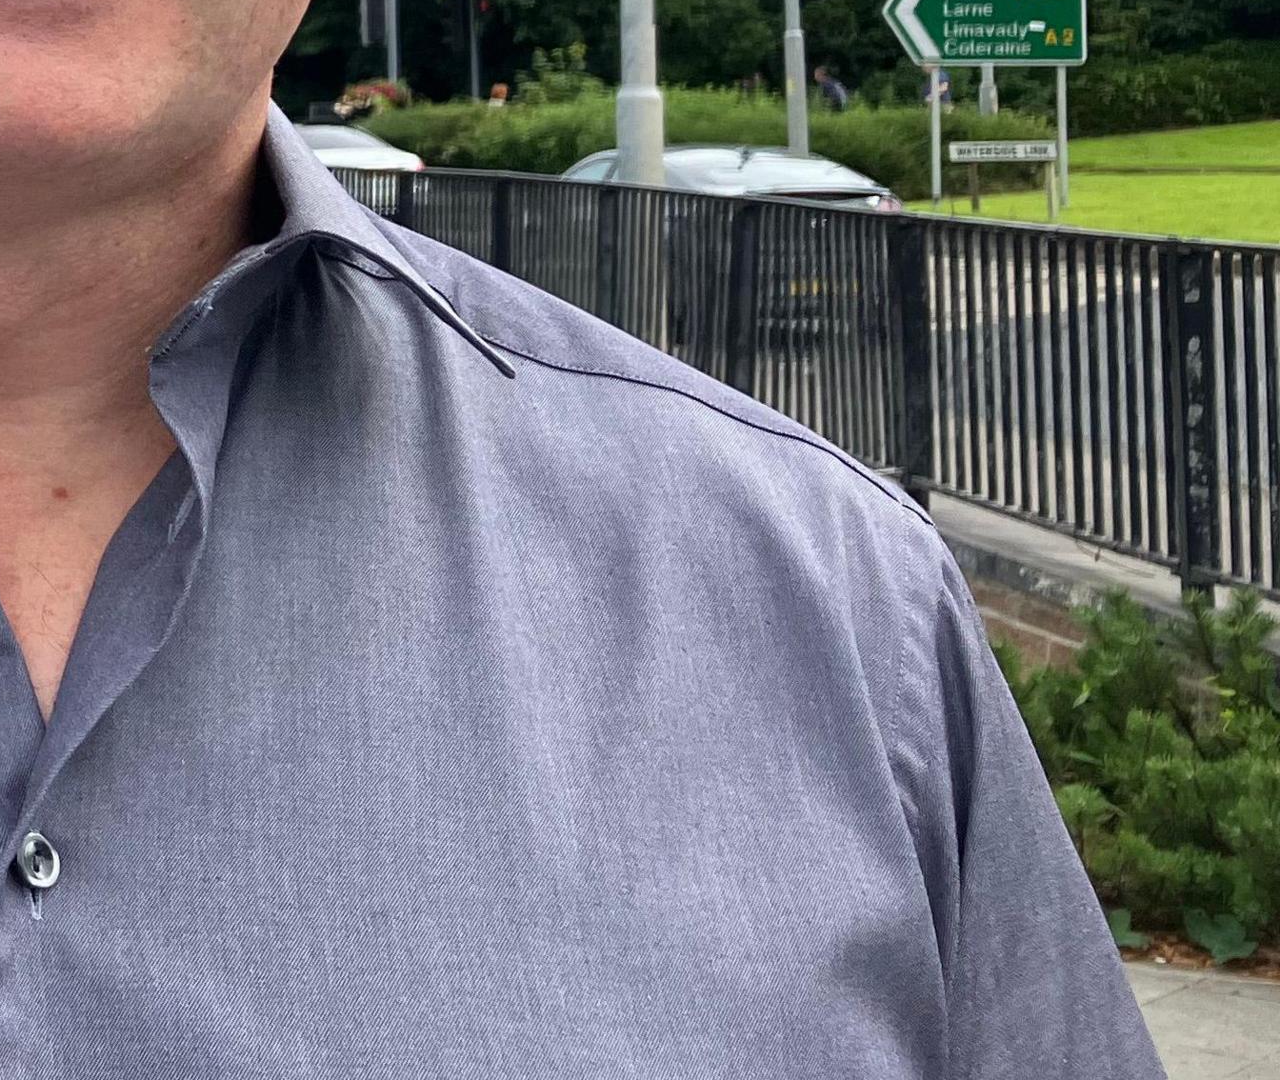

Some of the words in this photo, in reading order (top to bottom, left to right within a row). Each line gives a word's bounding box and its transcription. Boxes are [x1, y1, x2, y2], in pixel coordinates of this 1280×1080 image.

[943, 0, 993, 17] Larne
[944, 21, 1028, 40] Limavady
[944, 39, 1031, 56] Coleraine
